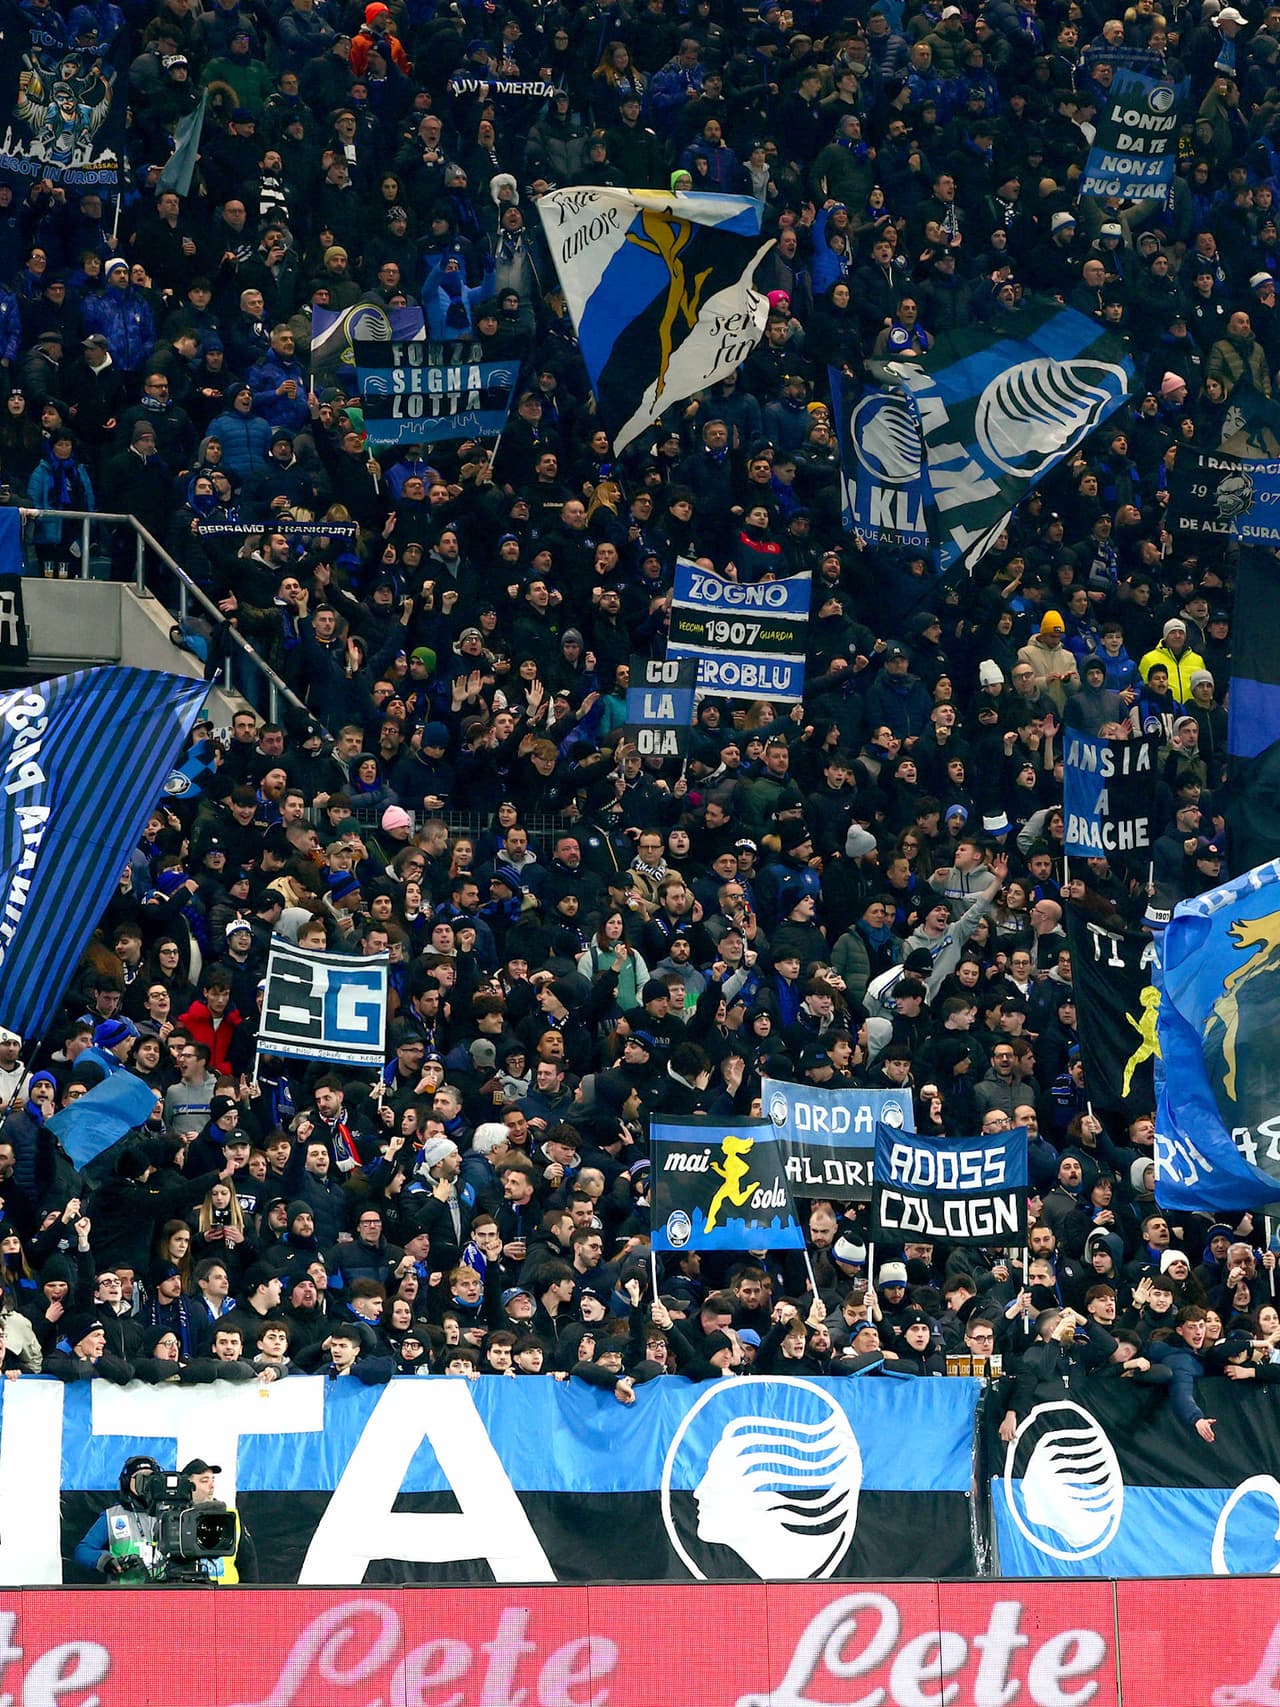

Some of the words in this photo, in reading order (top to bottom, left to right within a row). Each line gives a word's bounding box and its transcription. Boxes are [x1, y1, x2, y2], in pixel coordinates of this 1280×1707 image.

[496, 81, 553, 97] MERDA
[1116, 133, 1144, 152] DA
[1149, 138, 1168, 154] TE
[1101, 155, 1147, 176] NON
[1146, 160, 1164, 175] SI
[1123, 183, 1168, 199] STAR
[562, 207, 620, 264] amore
[391, 342, 483, 367] FORZA
[392, 365, 482, 394] SEGNA
[392, 390, 481, 419] LOTTA
[1190, 484, 1208, 497] 19
[1260, 492, 1280, 505] 07
[277, 525, 355, 537] FRANKFURT
[1180, 517, 1199, 530] DE
[879, 532, 893, 544] AL
[894, 534, 921, 546] TUO
[688, 573, 788, 607] ZOGNO
[679, 620, 704, 633] VECCHIA
[705, 620, 761, 645] 1907
[759, 630, 793, 641] GUARDIA
[646, 660, 679, 684] CO
[697, 658, 791, 690] EROBLU
[643, 693, 675, 720] LA
[1067, 740, 1151, 778] ANSIA
[1093, 788, 1110, 816] A
[1066, 813, 1150, 851] BRACHE
[1086, 921, 1126, 969] TI
[265, 956, 382, 1046] BG
[794, 1102, 873, 1134] ORDA
[664, 1147, 712, 1174] mai
[890, 1143, 1006, 1190] ADOSS
[750, 1175, 787, 1210] sola
[879, 1189, 1019, 1237] COLOGN
[227, 1598, 619, 1707] Lete
[736, 1592, 1108, 1707] Lete
